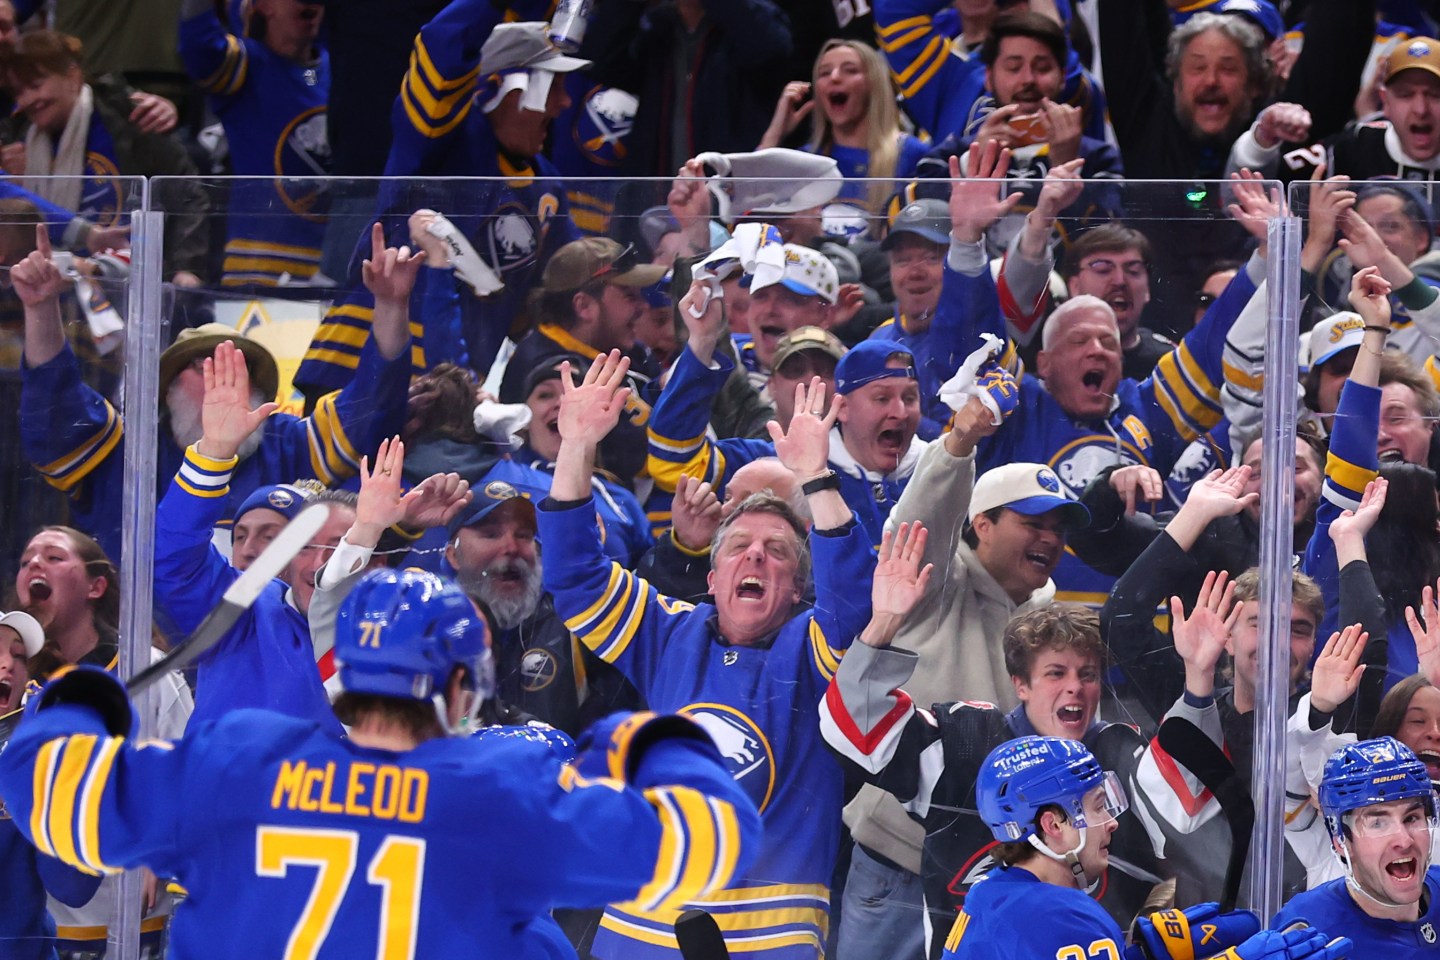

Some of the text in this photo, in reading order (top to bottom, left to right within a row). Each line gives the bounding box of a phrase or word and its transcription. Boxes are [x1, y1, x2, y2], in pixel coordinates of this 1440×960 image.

[1121, 414, 1154, 450] A
[358, 621, 382, 648] 71
[994, 743, 1049, 771] Trusted
[270, 760, 430, 824] McLEOD
[1372, 773, 1407, 785] BAUER
